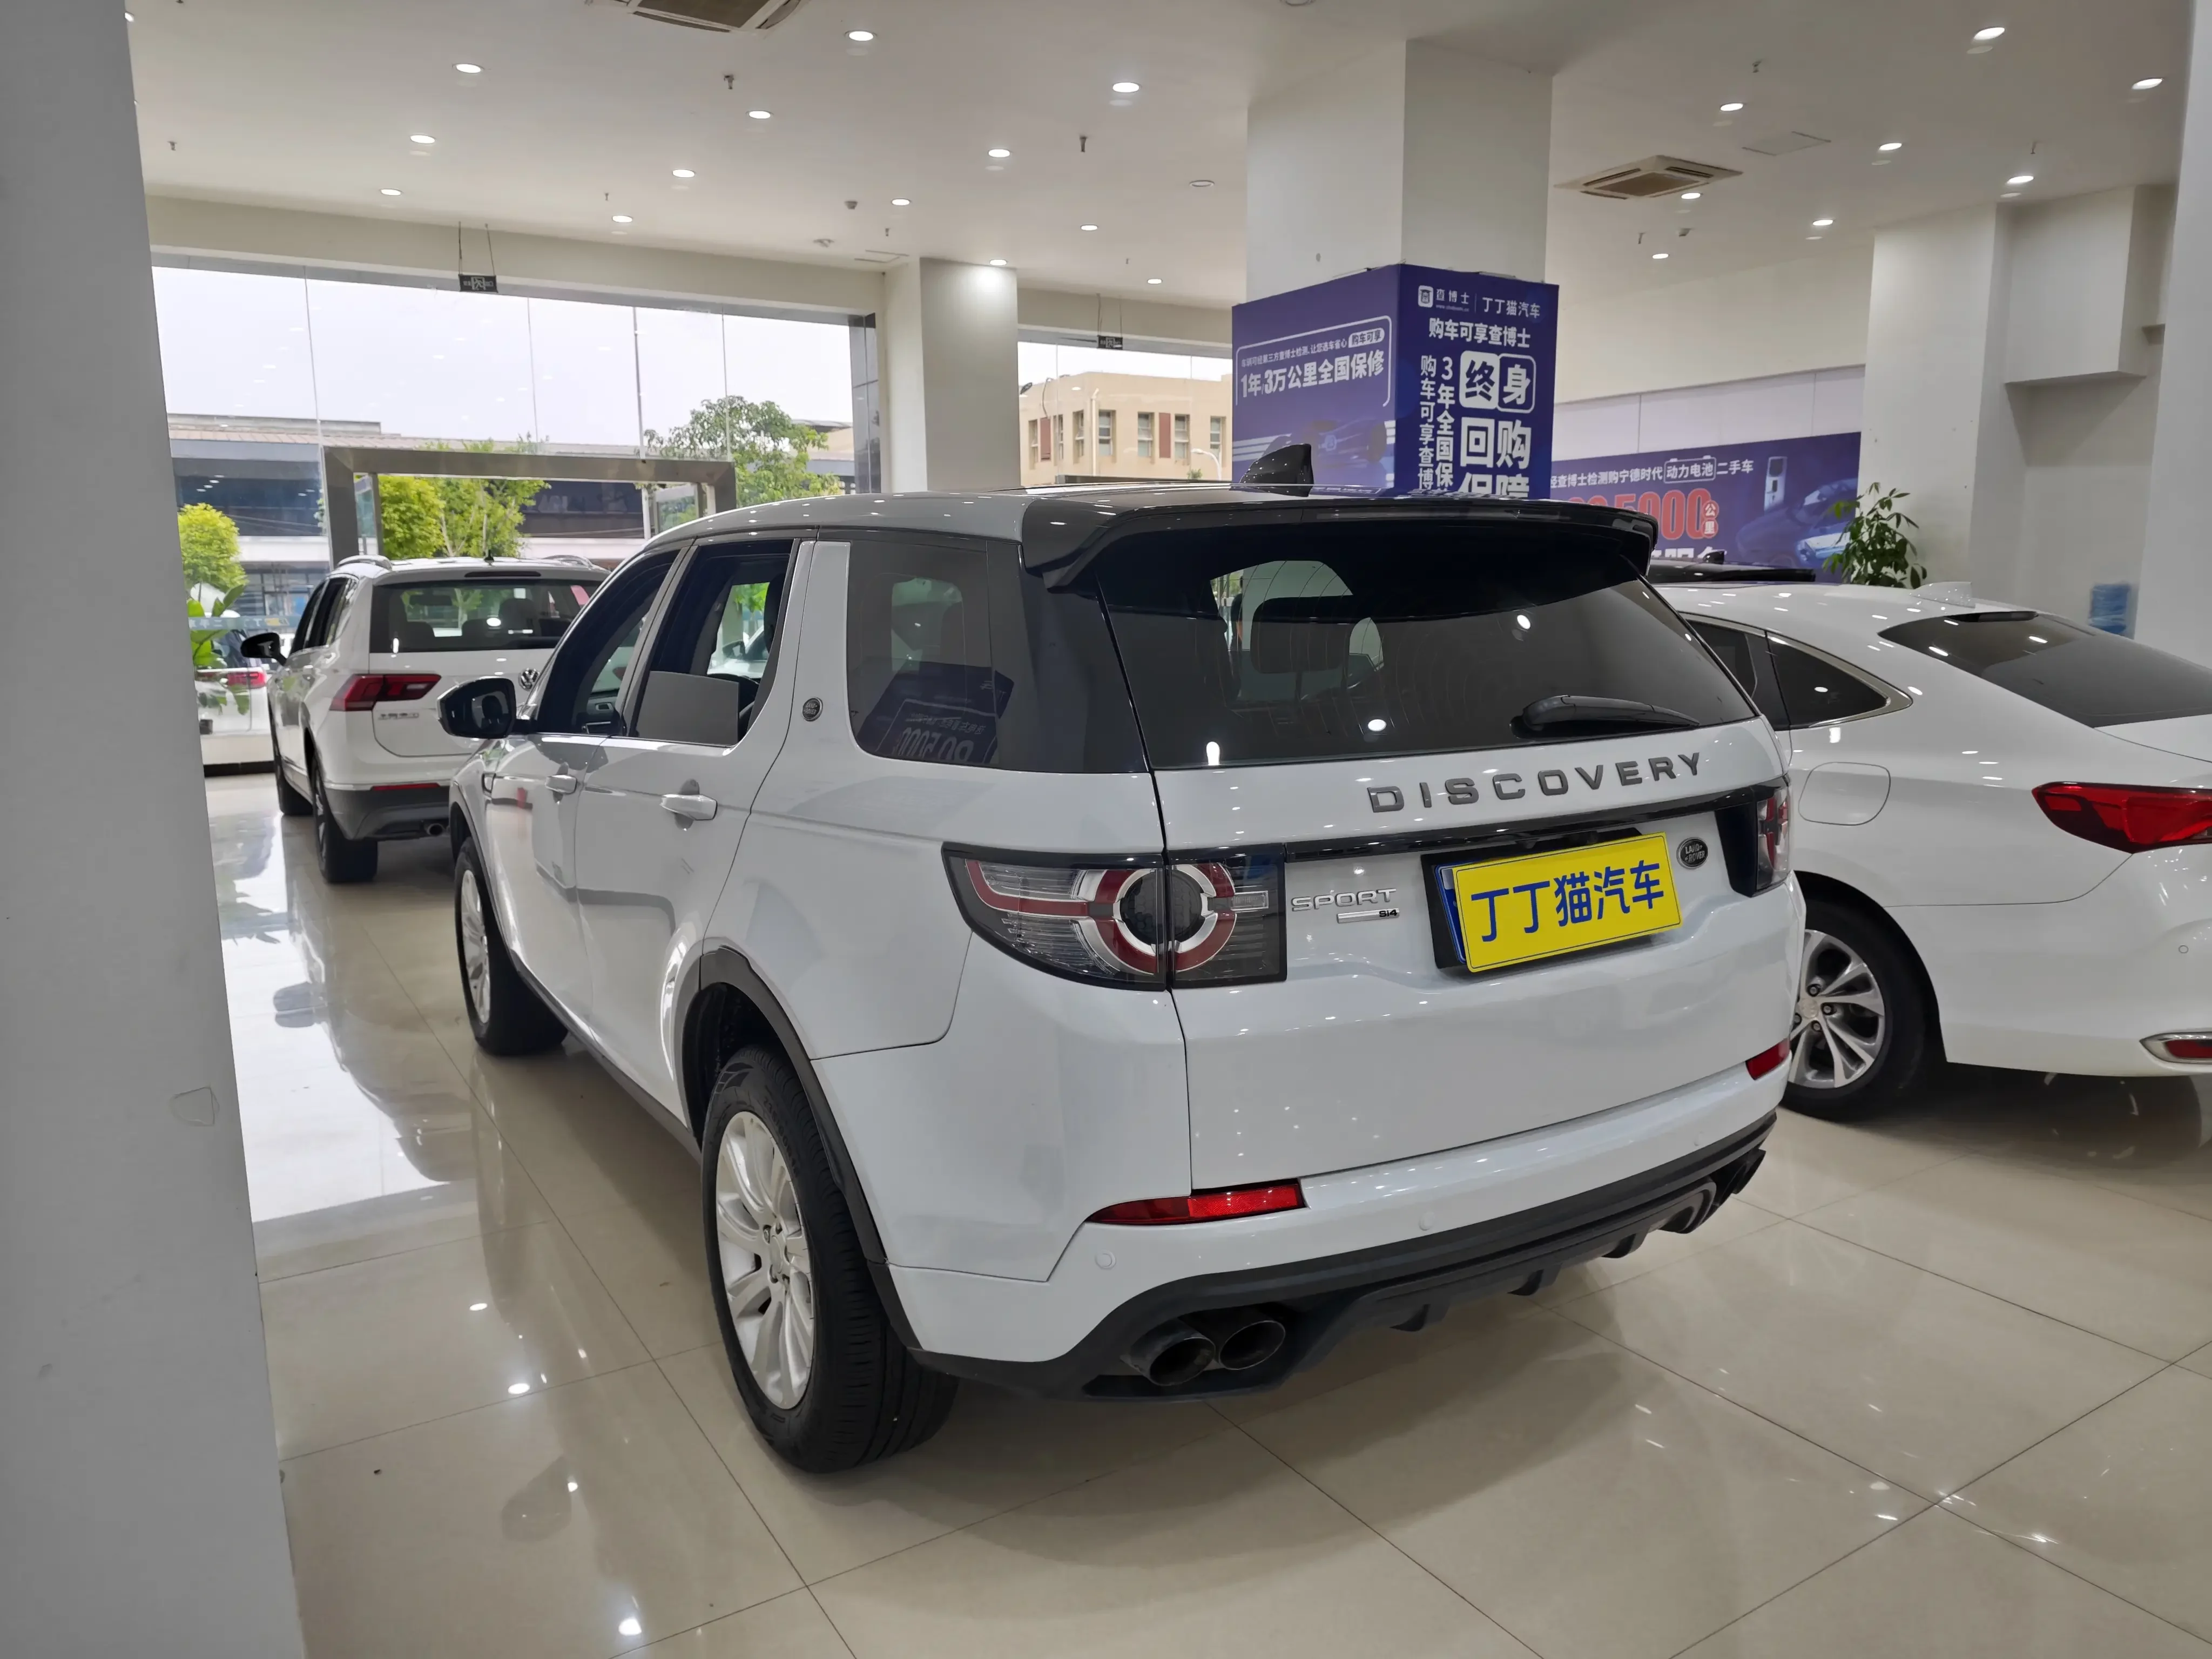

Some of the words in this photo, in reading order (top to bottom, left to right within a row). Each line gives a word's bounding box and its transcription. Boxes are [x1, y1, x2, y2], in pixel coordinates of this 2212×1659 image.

[1436, 288, 1469, 304] 查博士
[1482, 297, 1540, 318] 丁丁猫汽车
[1352, 329, 1381, 345] 购车可享
[1429, 318, 1530, 348] 购车可享查博士
[1465, 359, 1531, 405] 终身
[1435, 356, 1455, 491] 3年全国保
[1460, 416, 1532, 469] 回购
[1367, 752, 1700, 813] DISCOVERY
[1685, 844, 1700, 854] LAND
[1688, 850, 1705, 862] ROVER
[1291, 888, 1397, 912] SPORT
[1379, 909, 1398, 918] Si4
[1471, 860, 1664, 942] 丁丁猫汽车
